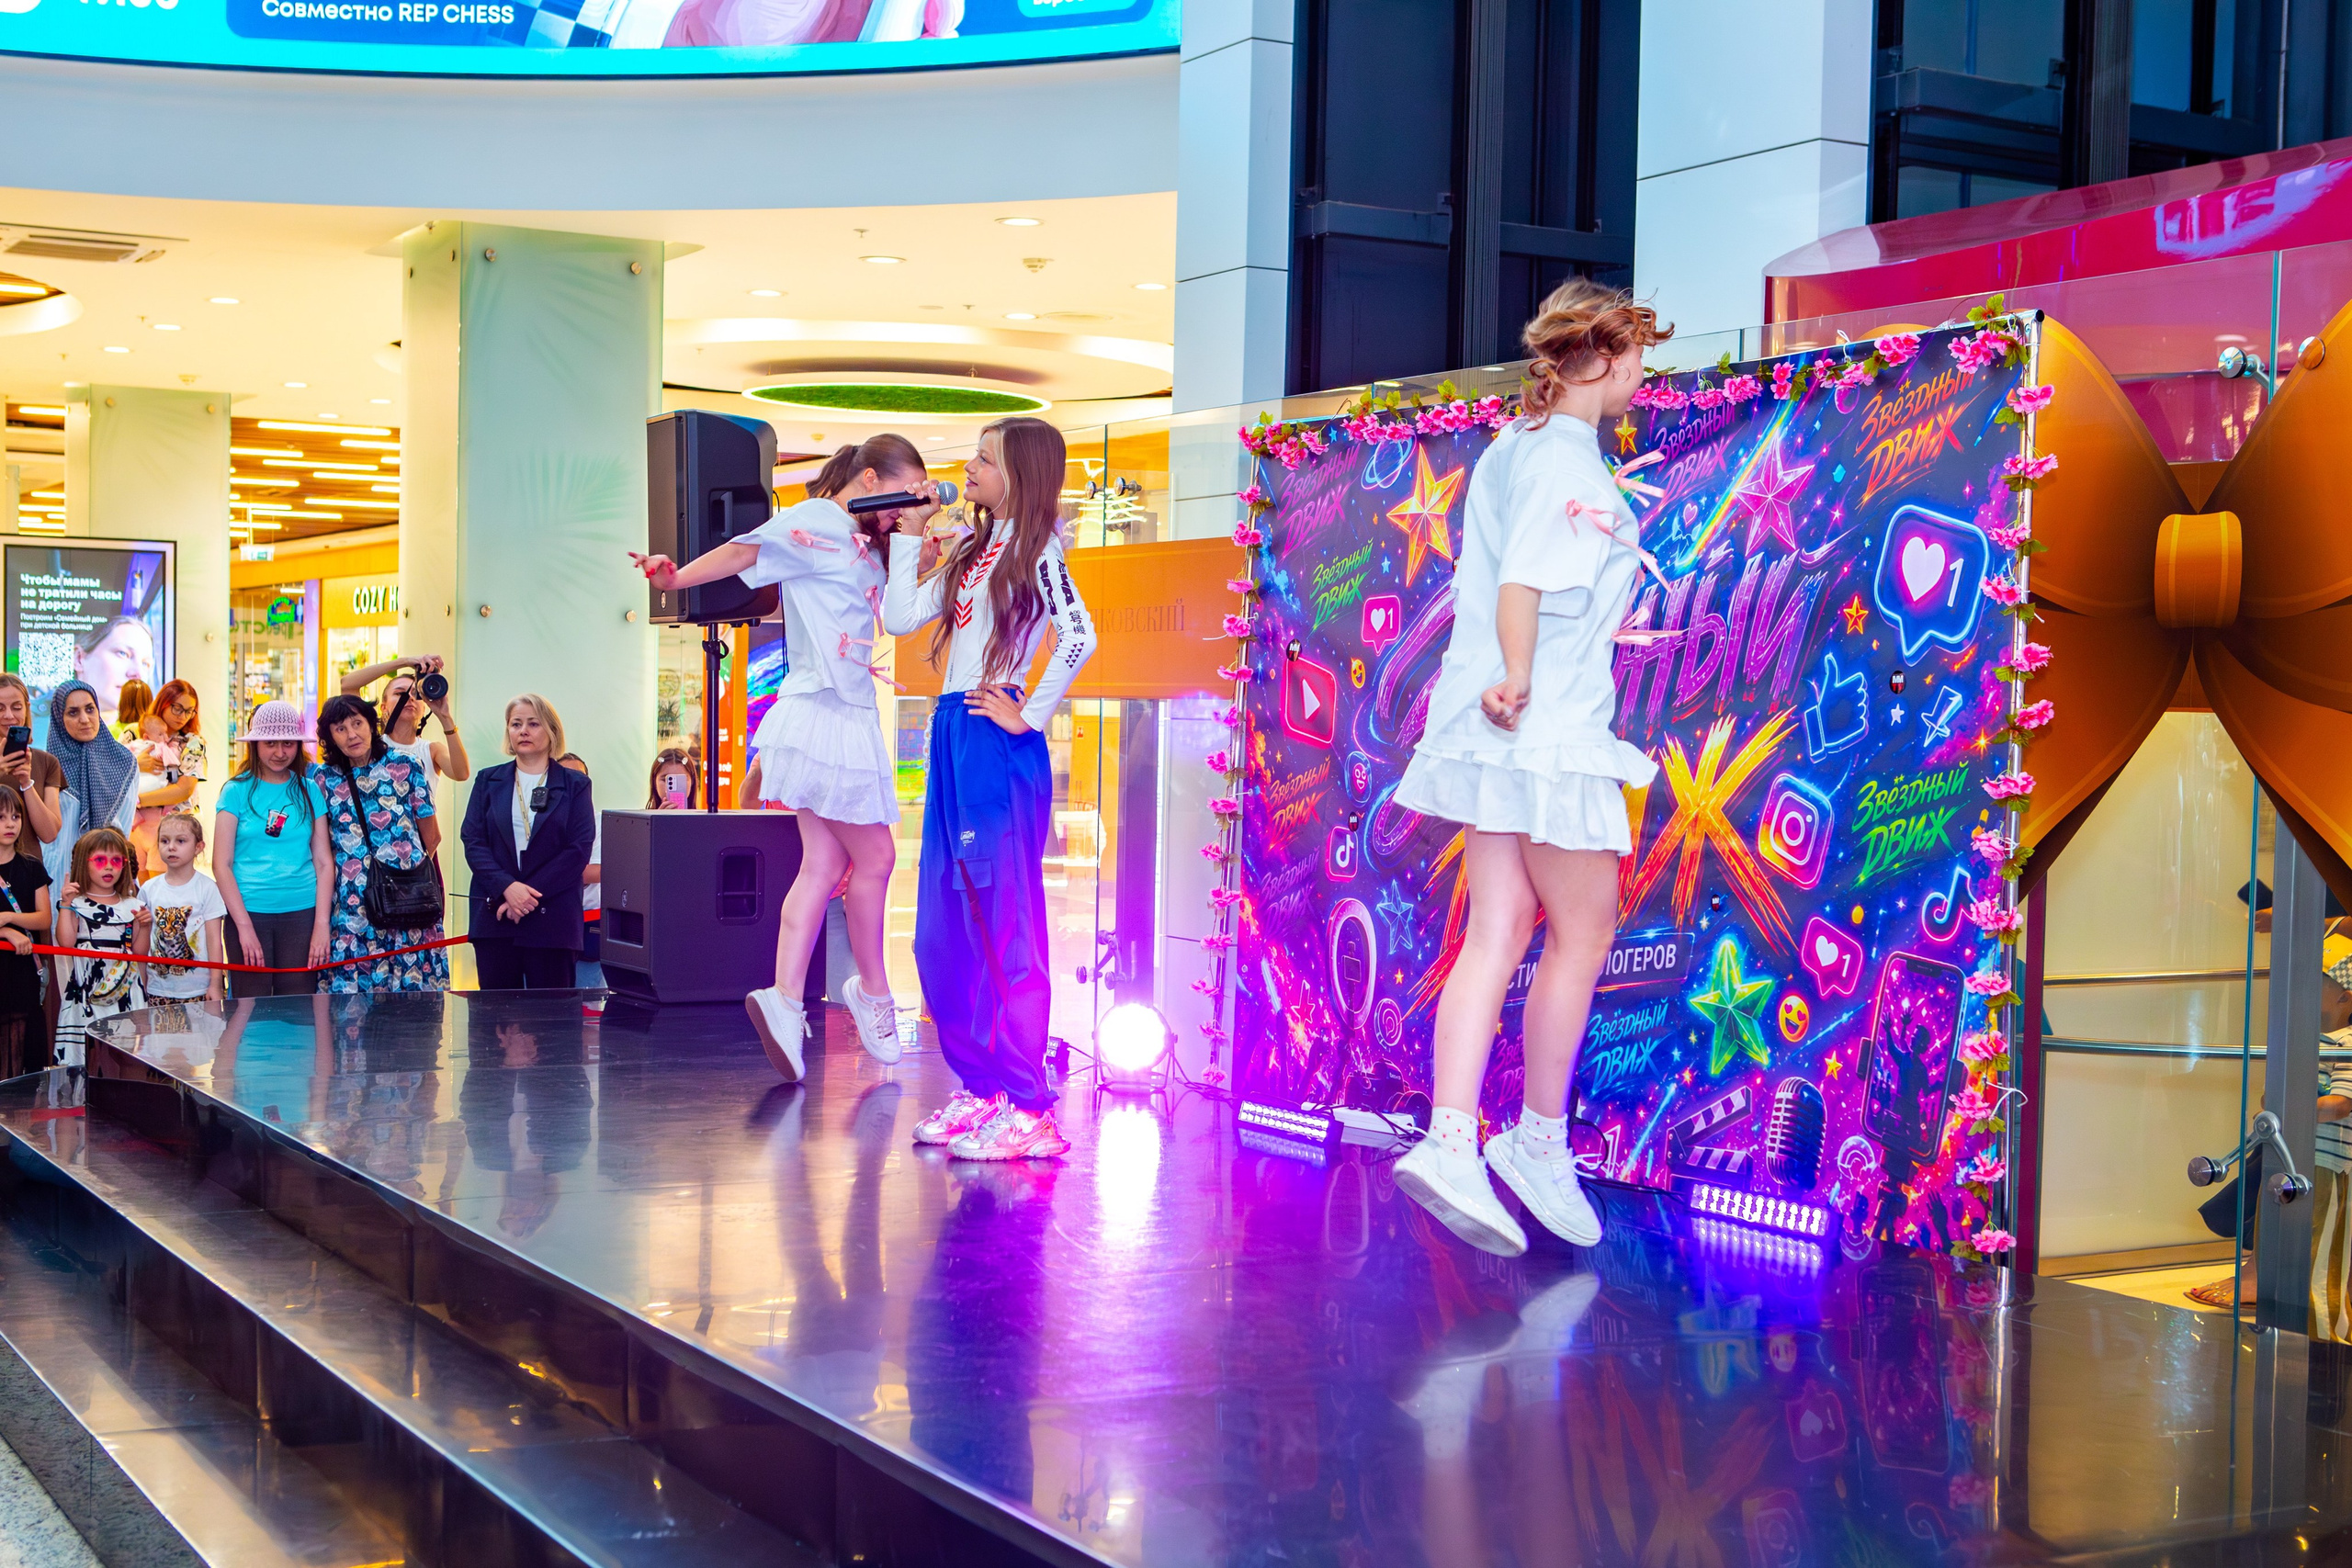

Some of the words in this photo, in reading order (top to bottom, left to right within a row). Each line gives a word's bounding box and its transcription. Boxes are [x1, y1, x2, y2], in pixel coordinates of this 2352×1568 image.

[399, 3, 438, 22] REP
[443, 5, 514, 24] CHESS
[20, 573, 61, 587] Чтобы
[62, 577, 100, 588] мамы
[1947, 558, 1964, 607] 1
[20, 588, 37, 597] не
[38, 588, 88, 600] тратили
[90, 591, 122, 601] часы
[353, 585, 386, 615] COZY
[389, 584, 399, 614] H
[20, 600, 37, 609] на
[38, 600, 82, 613] дорогу
[1387, 607, 1394, 630] 1
[1850, 805, 1963, 889] ДВИЖ
[1842, 953, 1850, 978] 1
